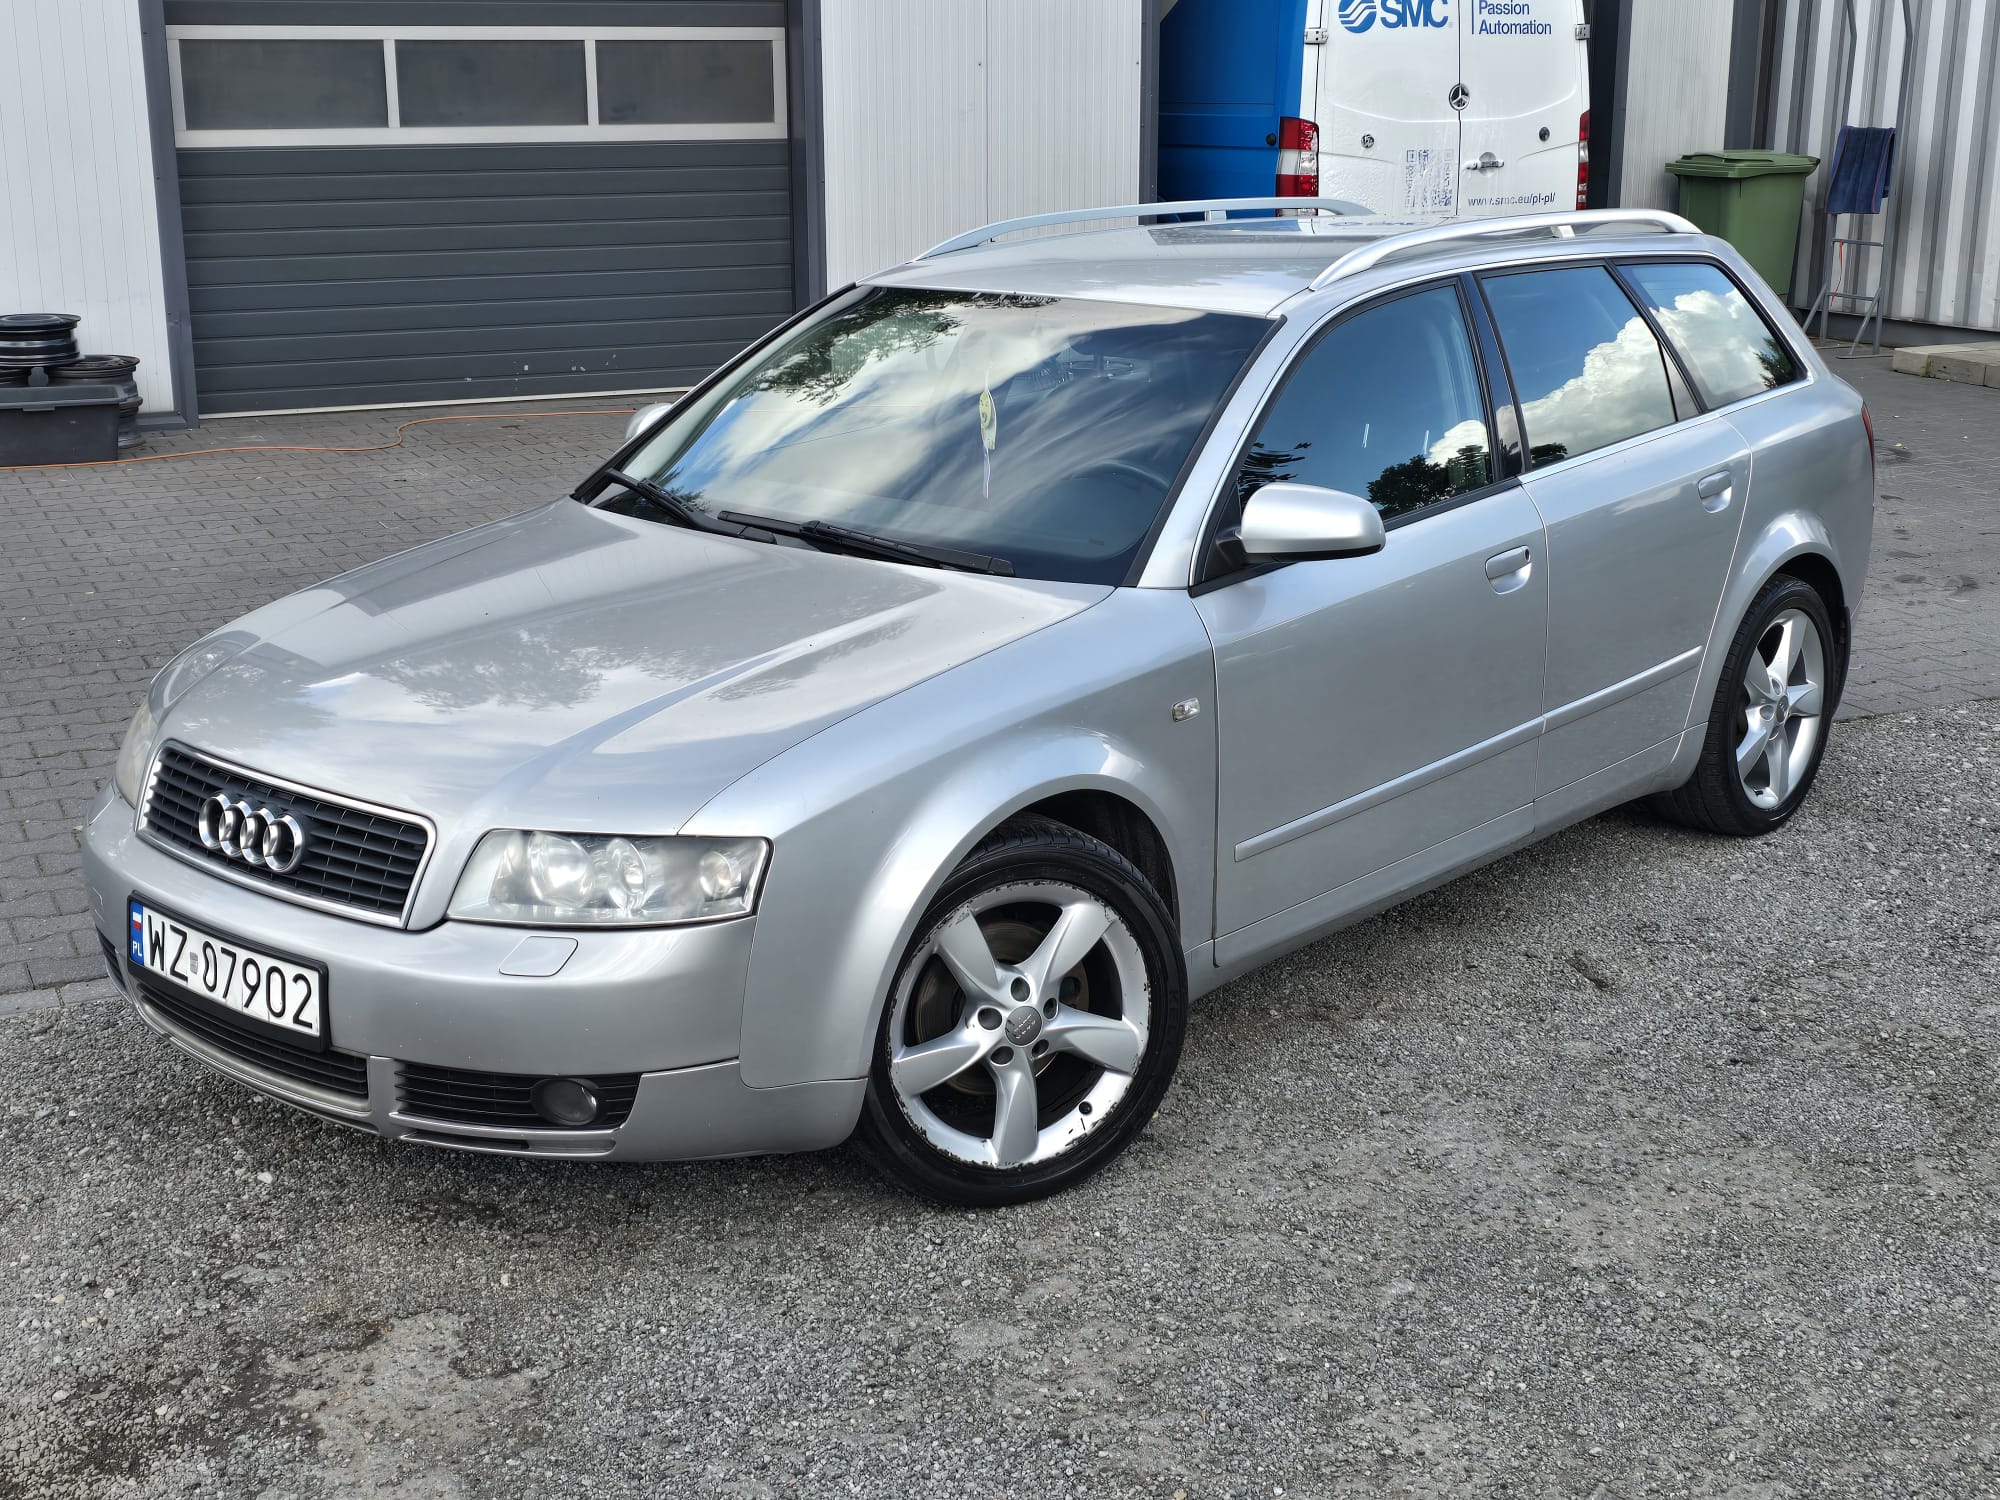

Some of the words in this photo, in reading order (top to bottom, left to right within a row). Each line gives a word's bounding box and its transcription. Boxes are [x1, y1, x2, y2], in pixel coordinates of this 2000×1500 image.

[1380, 0, 1448, 28] SMC
[1478, 0, 1530, 15] Passion
[1478, 19, 1552, 35] Automation
[132, 940, 143, 957] PL
[147, 914, 189, 984] WZ
[202, 940, 313, 1030] 07902
